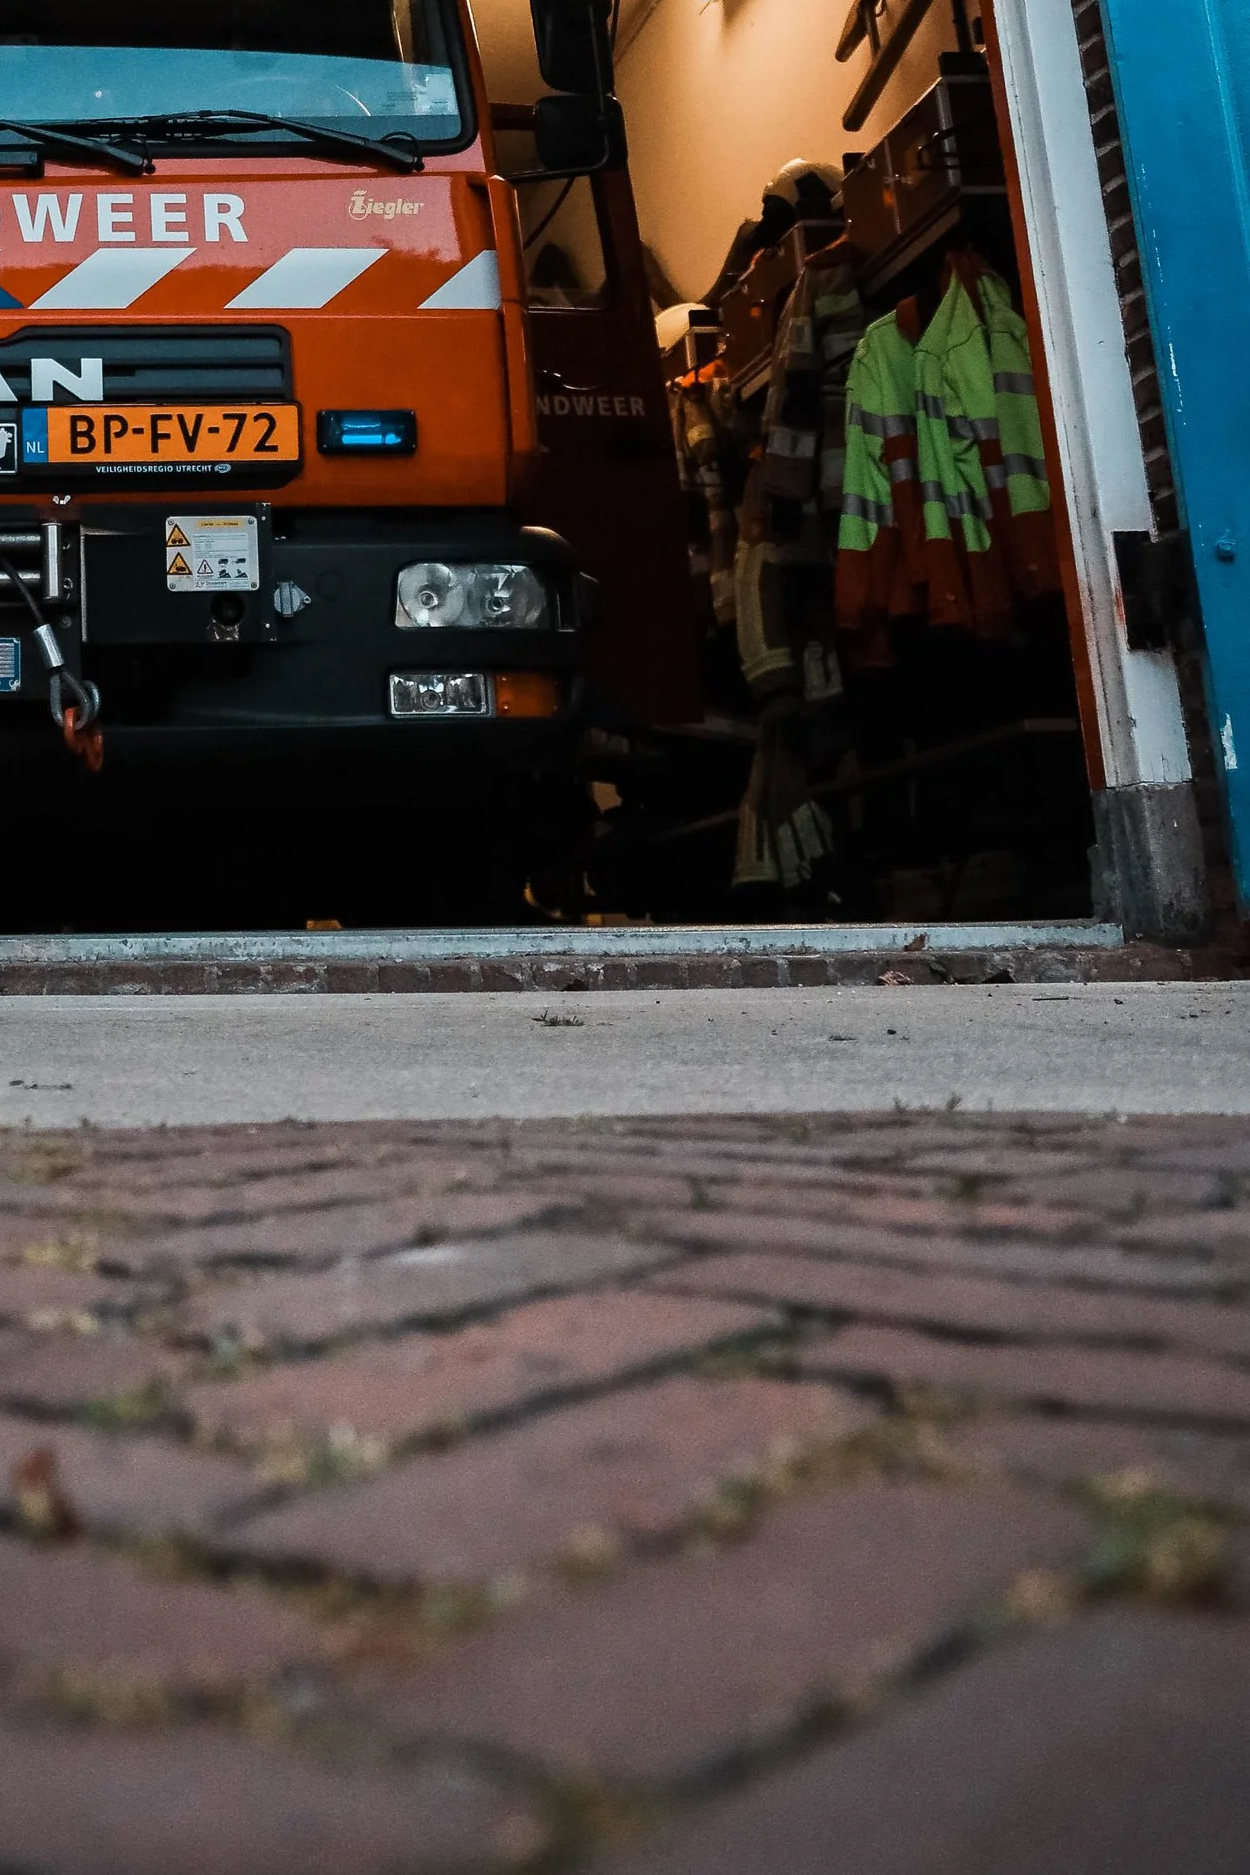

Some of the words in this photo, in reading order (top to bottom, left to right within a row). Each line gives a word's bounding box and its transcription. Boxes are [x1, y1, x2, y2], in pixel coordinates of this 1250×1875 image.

[349, 190, 425, 221] Ziegler
[69, 412, 279, 455] BP-FV-72
[26, 441, 45, 455] NL
[96, 464, 174, 474] VEILIGHEIDSREGIO
[175, 463, 213, 473] UTRECHT
